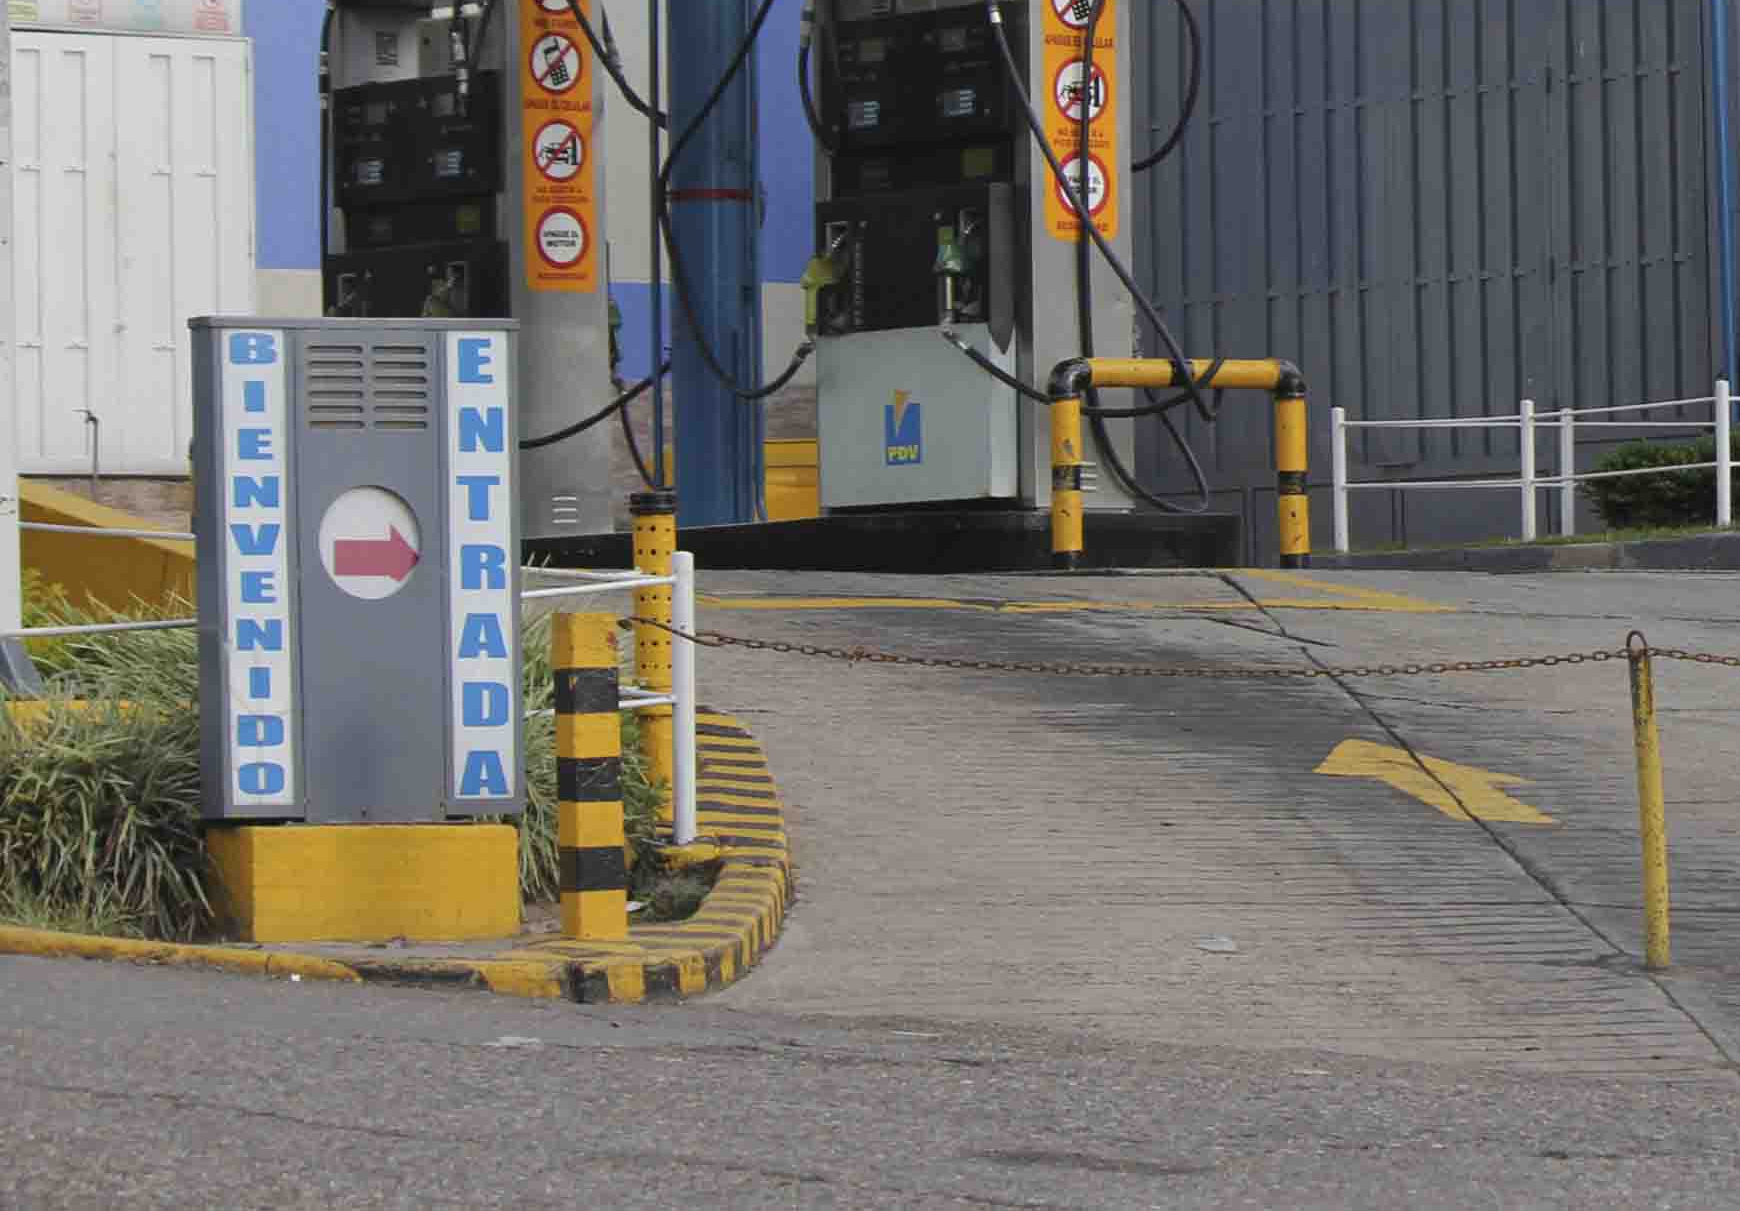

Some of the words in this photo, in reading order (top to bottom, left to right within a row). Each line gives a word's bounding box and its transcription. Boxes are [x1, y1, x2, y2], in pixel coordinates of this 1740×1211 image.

[229, 332, 285, 795] BIENVENIDO
[456, 338, 513, 797] ENTRADA
[887, 445, 919, 461] PDV
